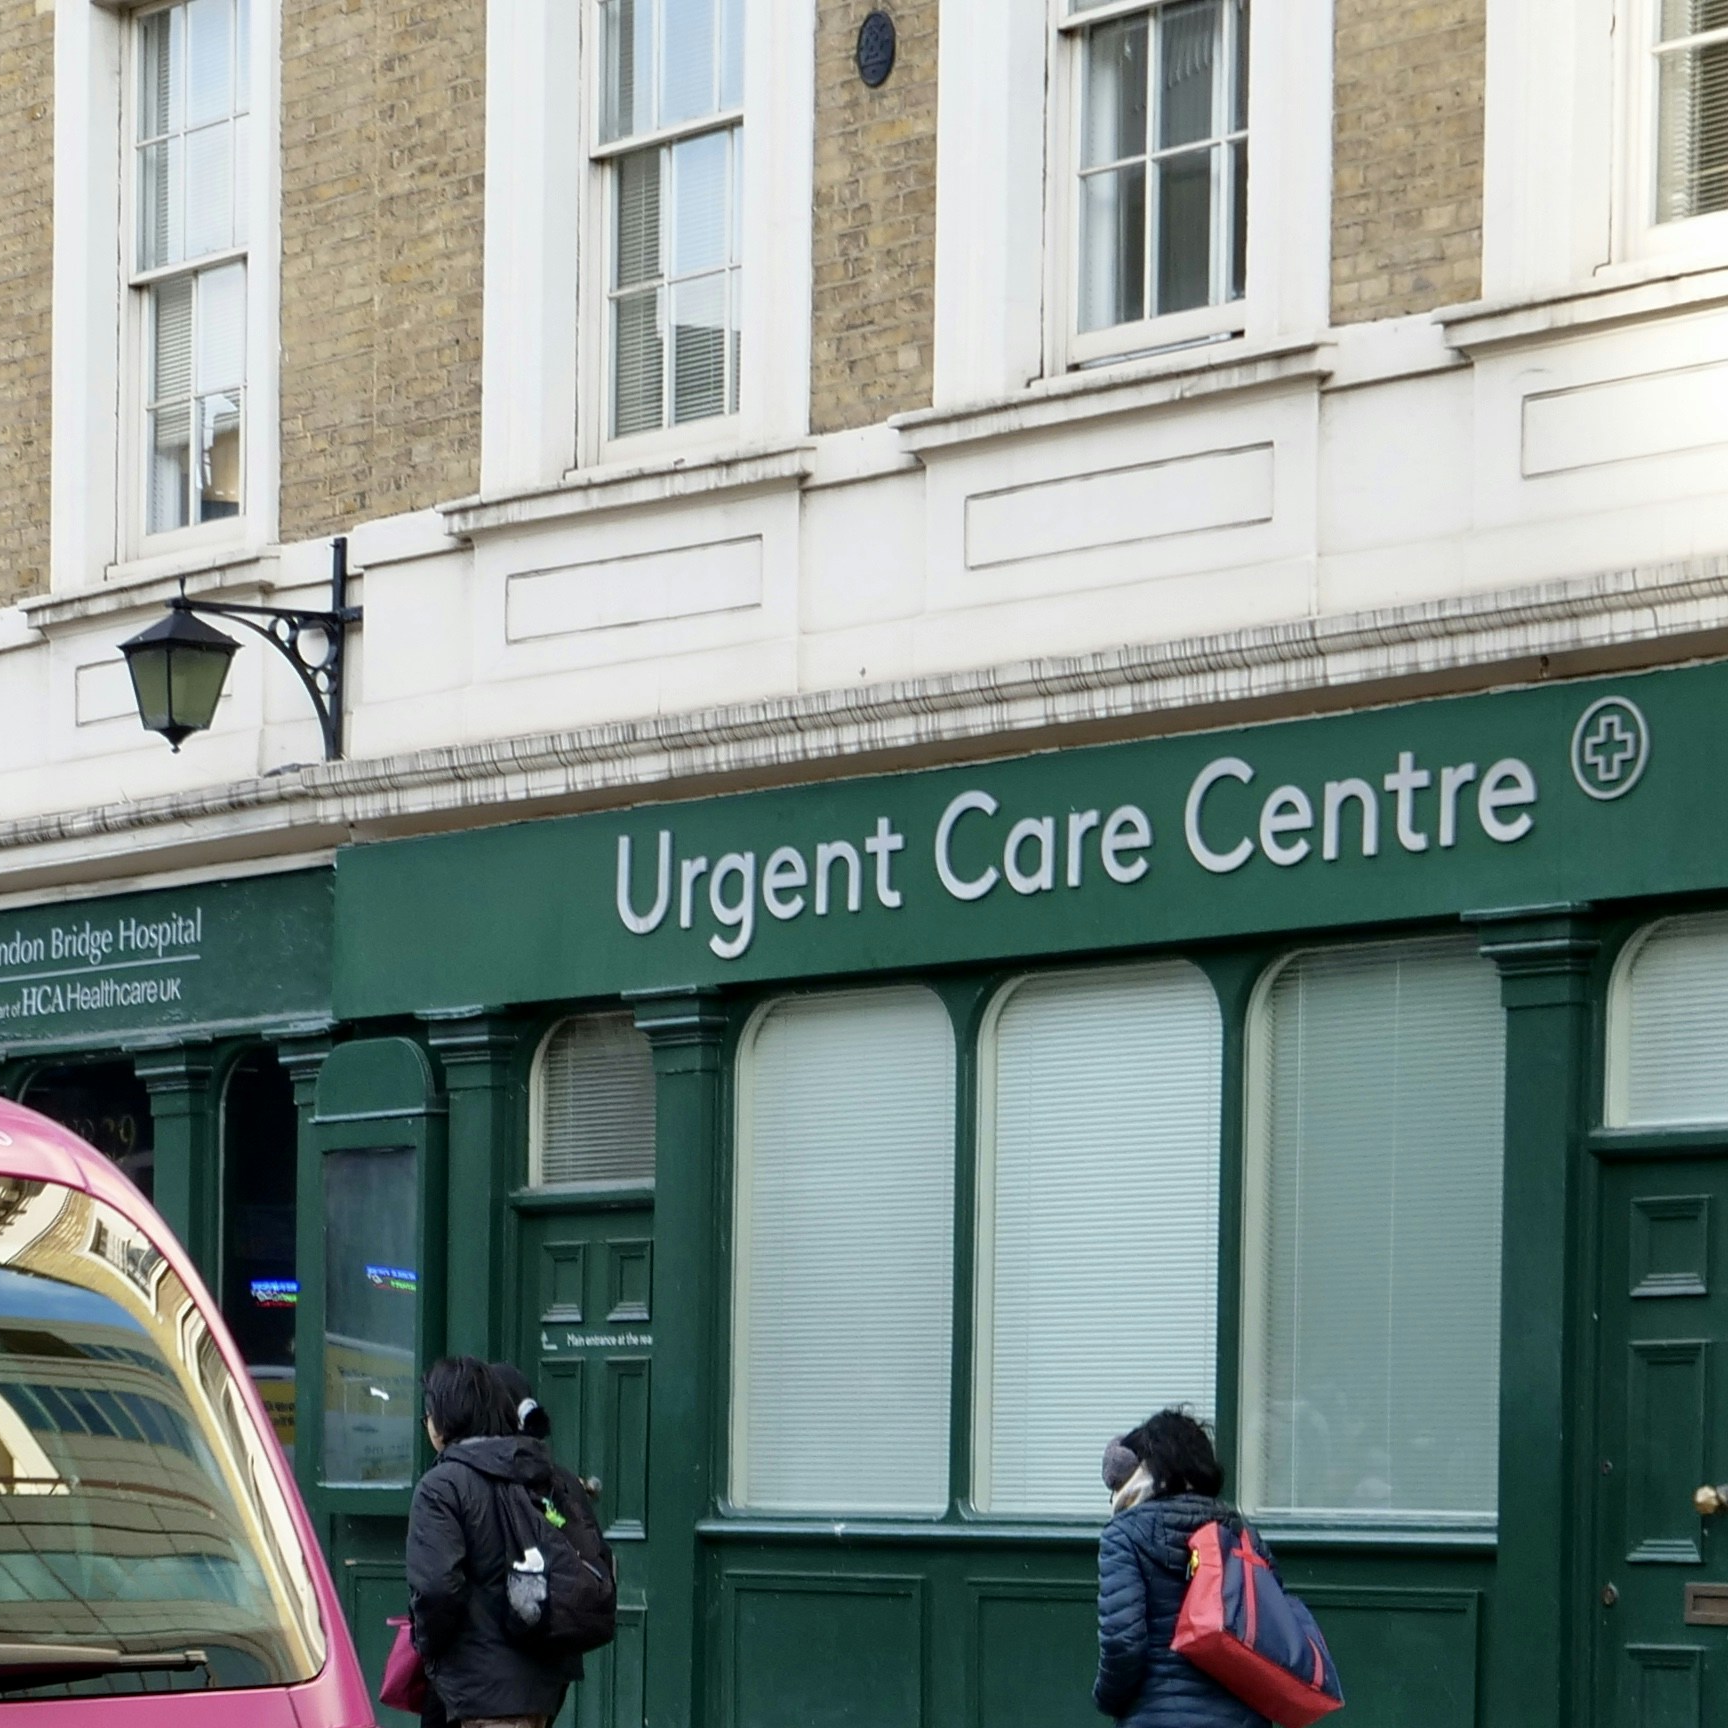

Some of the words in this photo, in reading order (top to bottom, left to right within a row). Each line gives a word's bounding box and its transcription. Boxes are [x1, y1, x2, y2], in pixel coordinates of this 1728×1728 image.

[613, 815, 906, 960] Urgent
[932, 788, 1154, 902] Care
[1183, 749, 1537, 874] Centre
[51, 920, 113, 965] Bridge
[119, 906, 202, 957] Hospital
[11, 1003, 22, 1018] of
[22, 984, 65, 1016] HCA
[66, 978, 158, 1011] Healthcare
[159, 978, 182, 1001] UK
